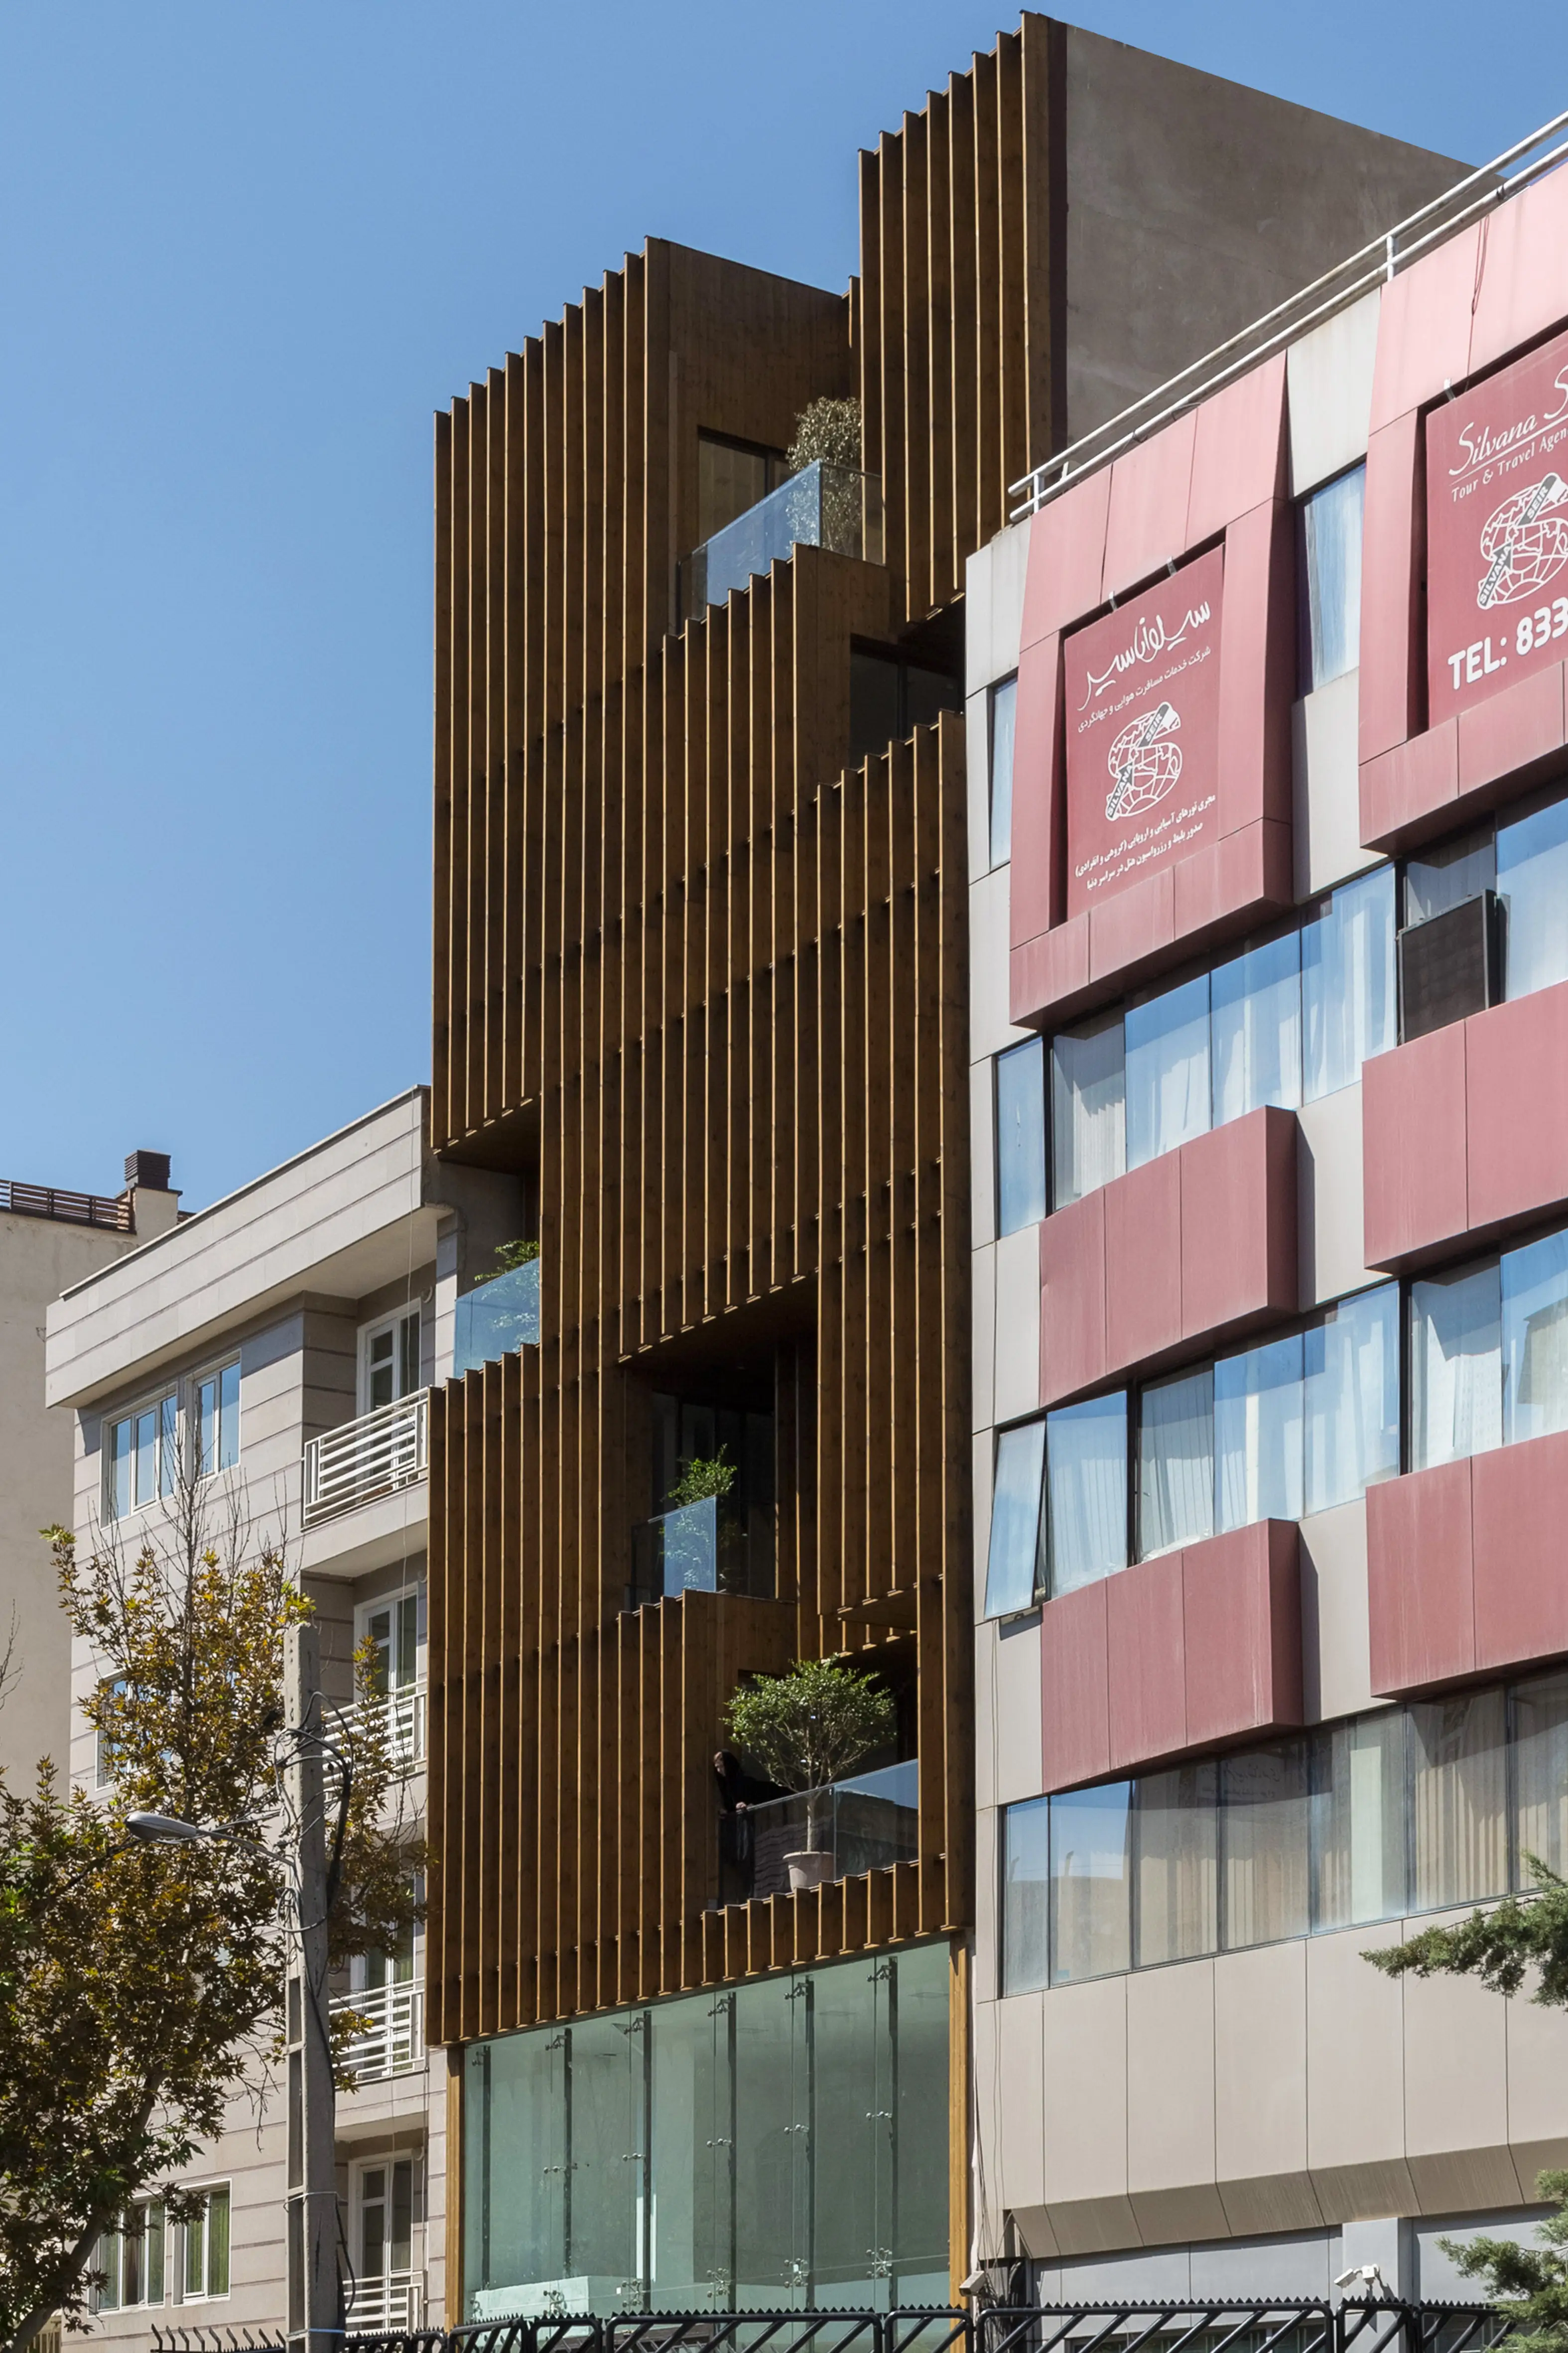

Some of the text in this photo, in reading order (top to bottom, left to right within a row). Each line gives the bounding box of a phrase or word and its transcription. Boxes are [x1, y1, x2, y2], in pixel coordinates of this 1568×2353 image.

[1448, 415, 1538, 476] Silvana
[1451, 479, 1478, 502] Tour
[1482, 469, 1493, 485] &
[1497, 442, 1535, 476] Travel
[1479, 486, 1549, 605] SILVANA SEIR
[1165, 659, 1187, 679] خدمات
[1189, 646, 1210, 665] شرکت
[1447, 597, 1568, 690] TEL: 833
[1136, 675, 1163, 696] مسافرت
[1108, 713, 1163, 816] SILVANA SEIR
